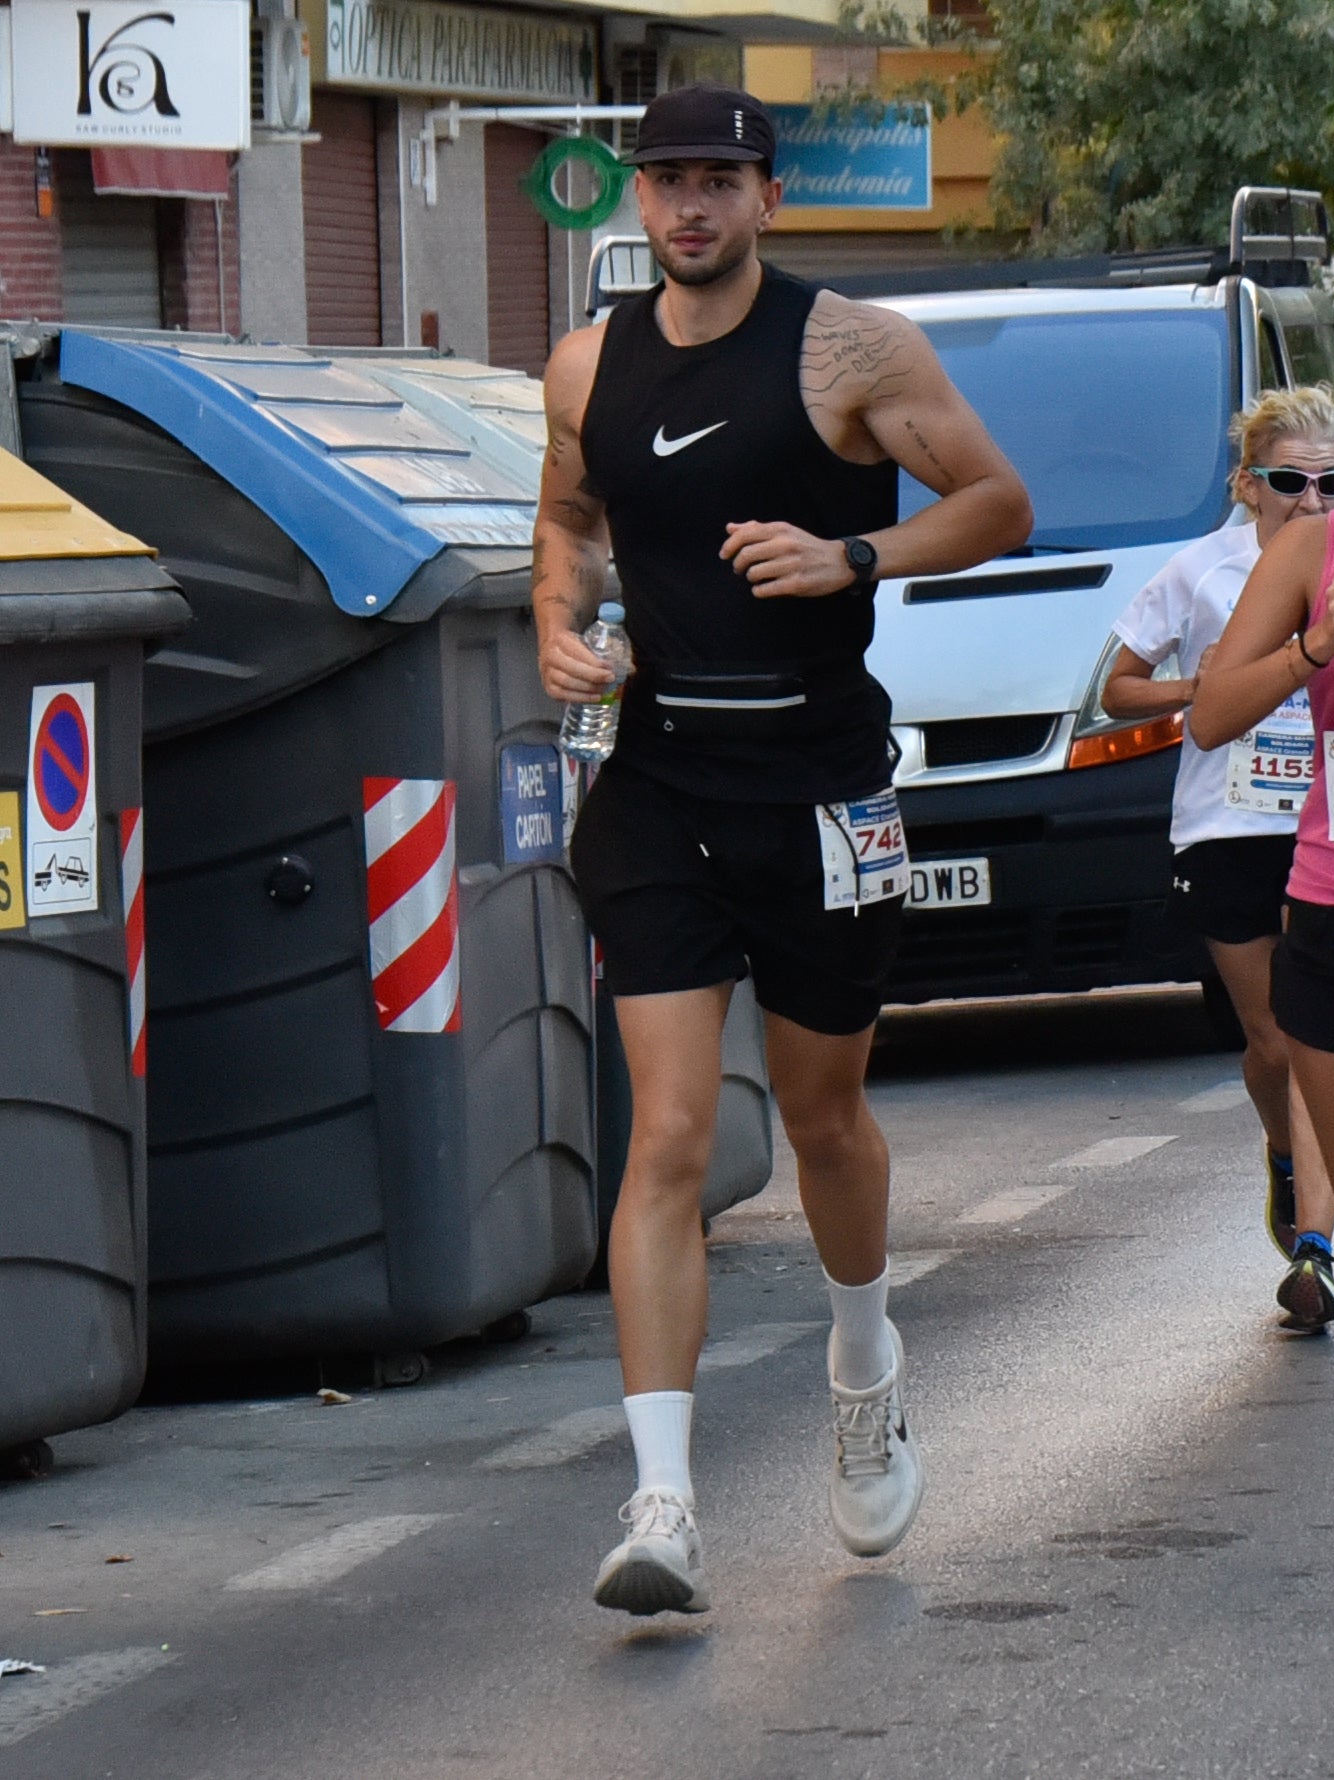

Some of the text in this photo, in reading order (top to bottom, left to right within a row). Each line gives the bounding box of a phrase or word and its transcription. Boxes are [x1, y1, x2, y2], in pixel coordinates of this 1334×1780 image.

[517, 763, 547, 799] PAPEL
[1250, 756, 1315, 779] 1153
[515, 804, 553, 849] CARTÓN
[856, 823, 902, 857] 742
[910, 866, 979, 903] DWB
